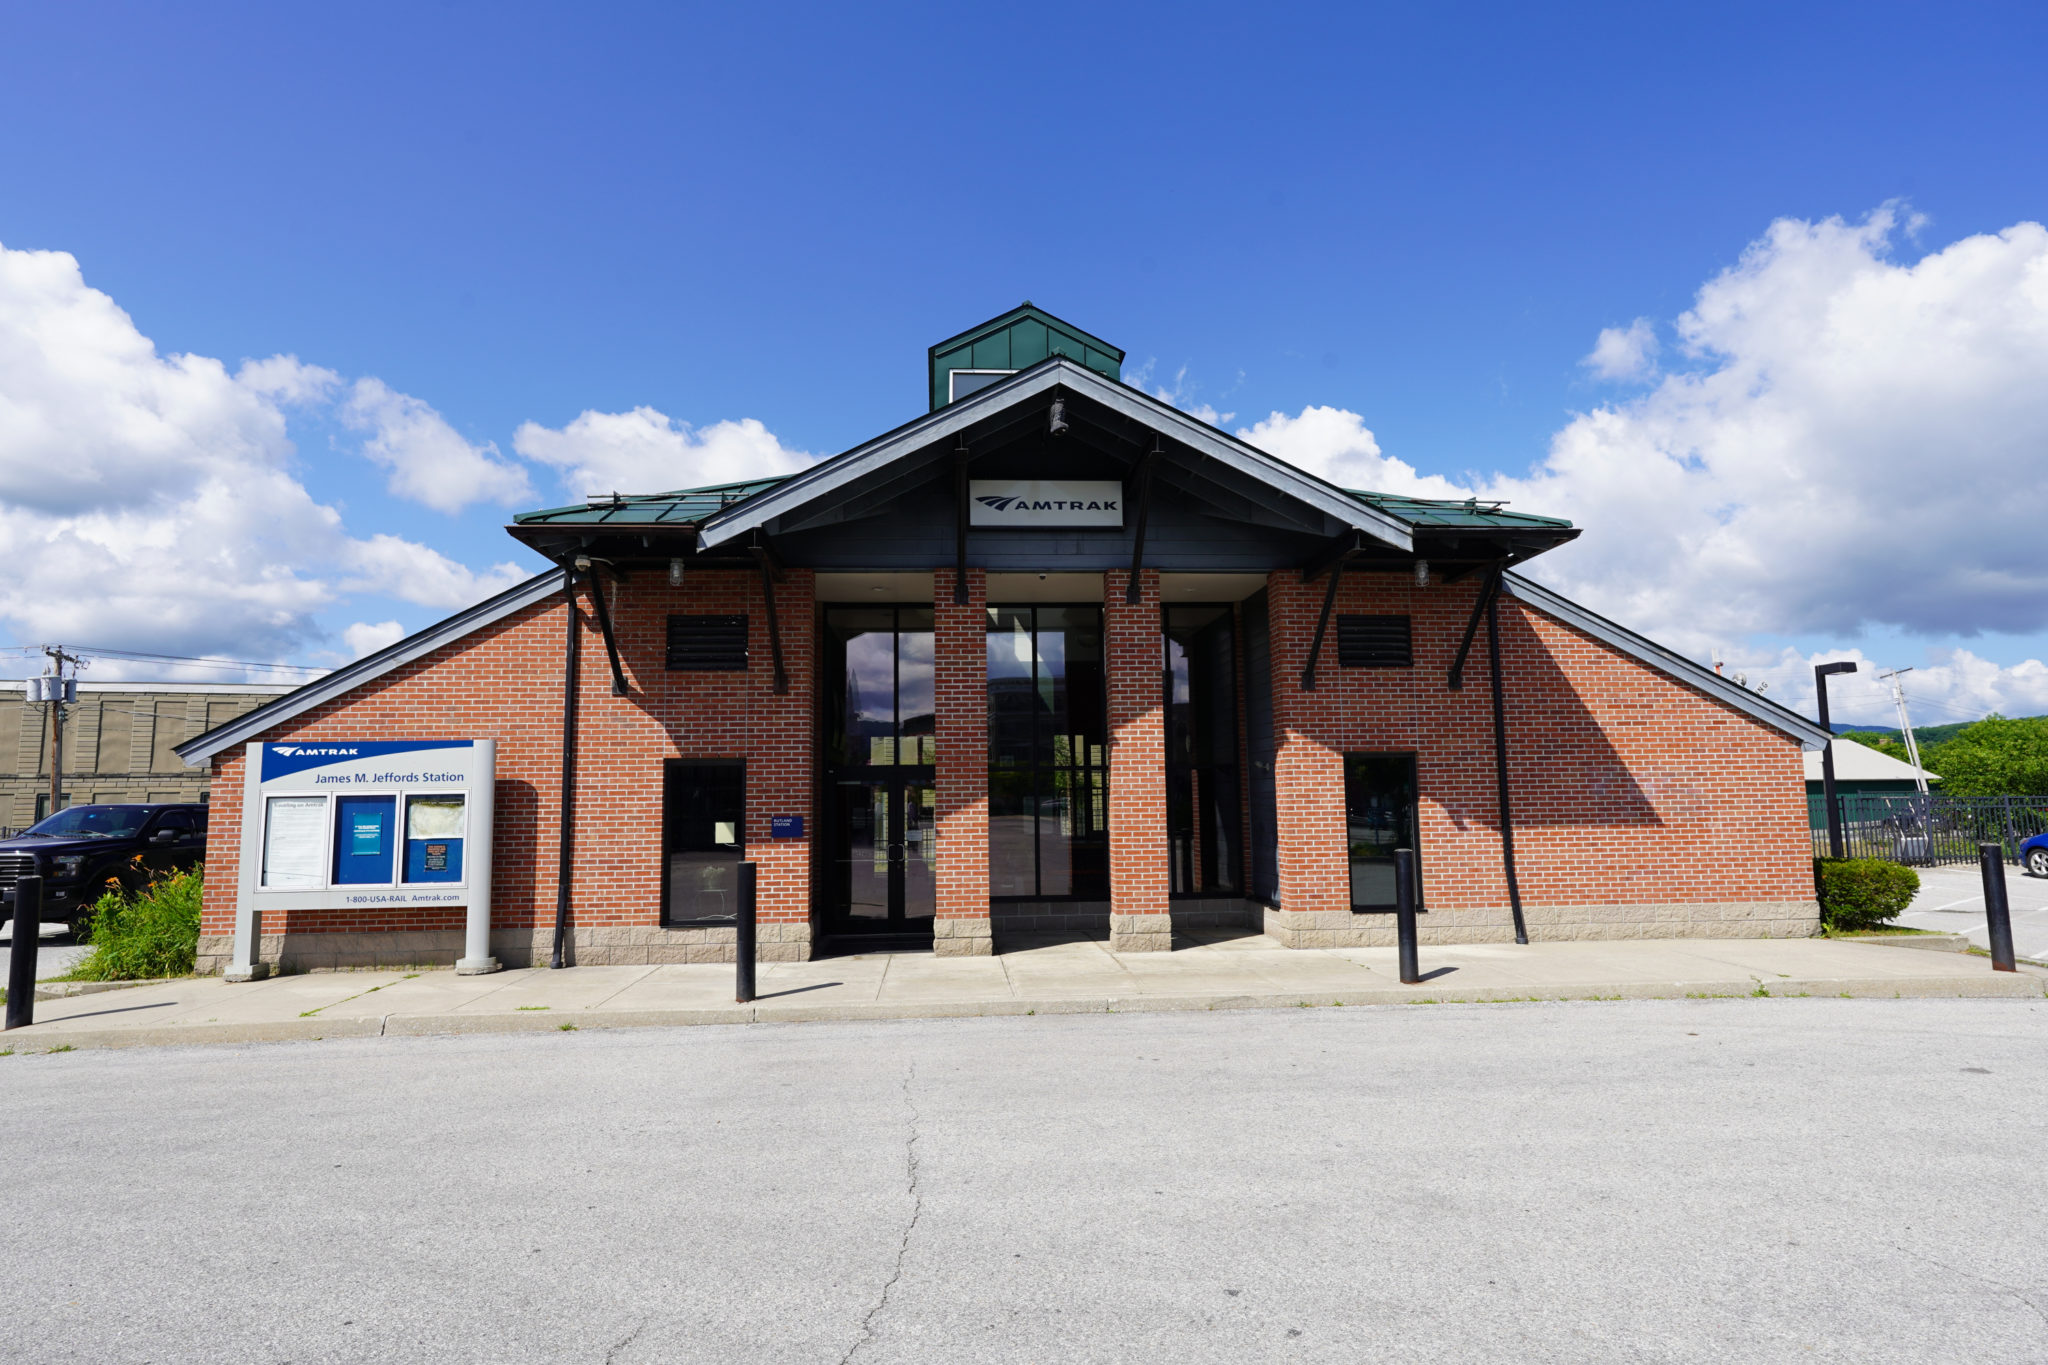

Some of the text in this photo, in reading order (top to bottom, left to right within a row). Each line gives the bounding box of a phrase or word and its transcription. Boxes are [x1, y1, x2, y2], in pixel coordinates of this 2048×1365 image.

[1015, 501, 1117, 510] AMTRAK
[295, 748, 358, 756] AMTRAK
[315, 772, 464, 783] James M. Jeffords Station
[346, 894, 460, 903] 1-800-USA-RAIL Amtrak.com
